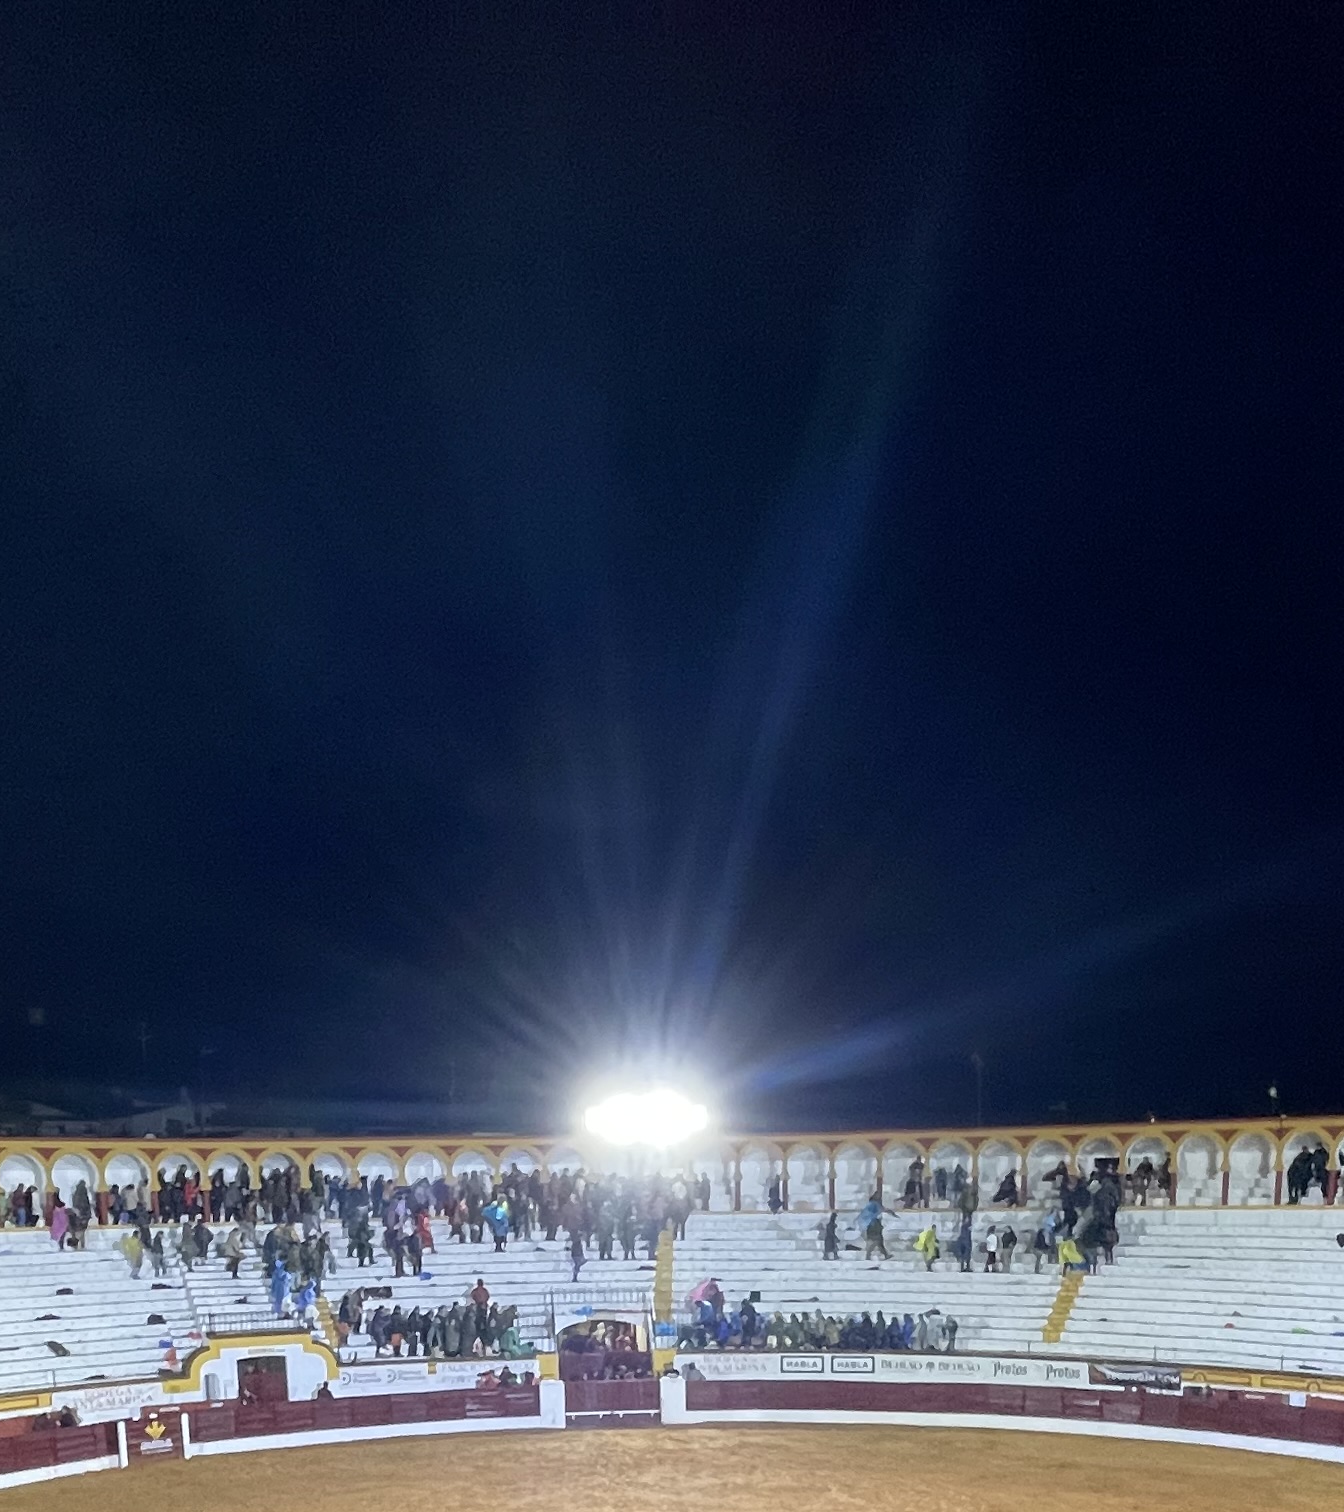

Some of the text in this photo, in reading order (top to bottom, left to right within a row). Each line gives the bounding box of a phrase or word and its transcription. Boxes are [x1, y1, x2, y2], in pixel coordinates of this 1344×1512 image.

[785, 1360, 818, 1369] HABLA
[836, 1361, 869, 1370] HABLA
[993, 1360, 1028, 1378] Protos
[1045, 1363, 1081, 1380] Protos
